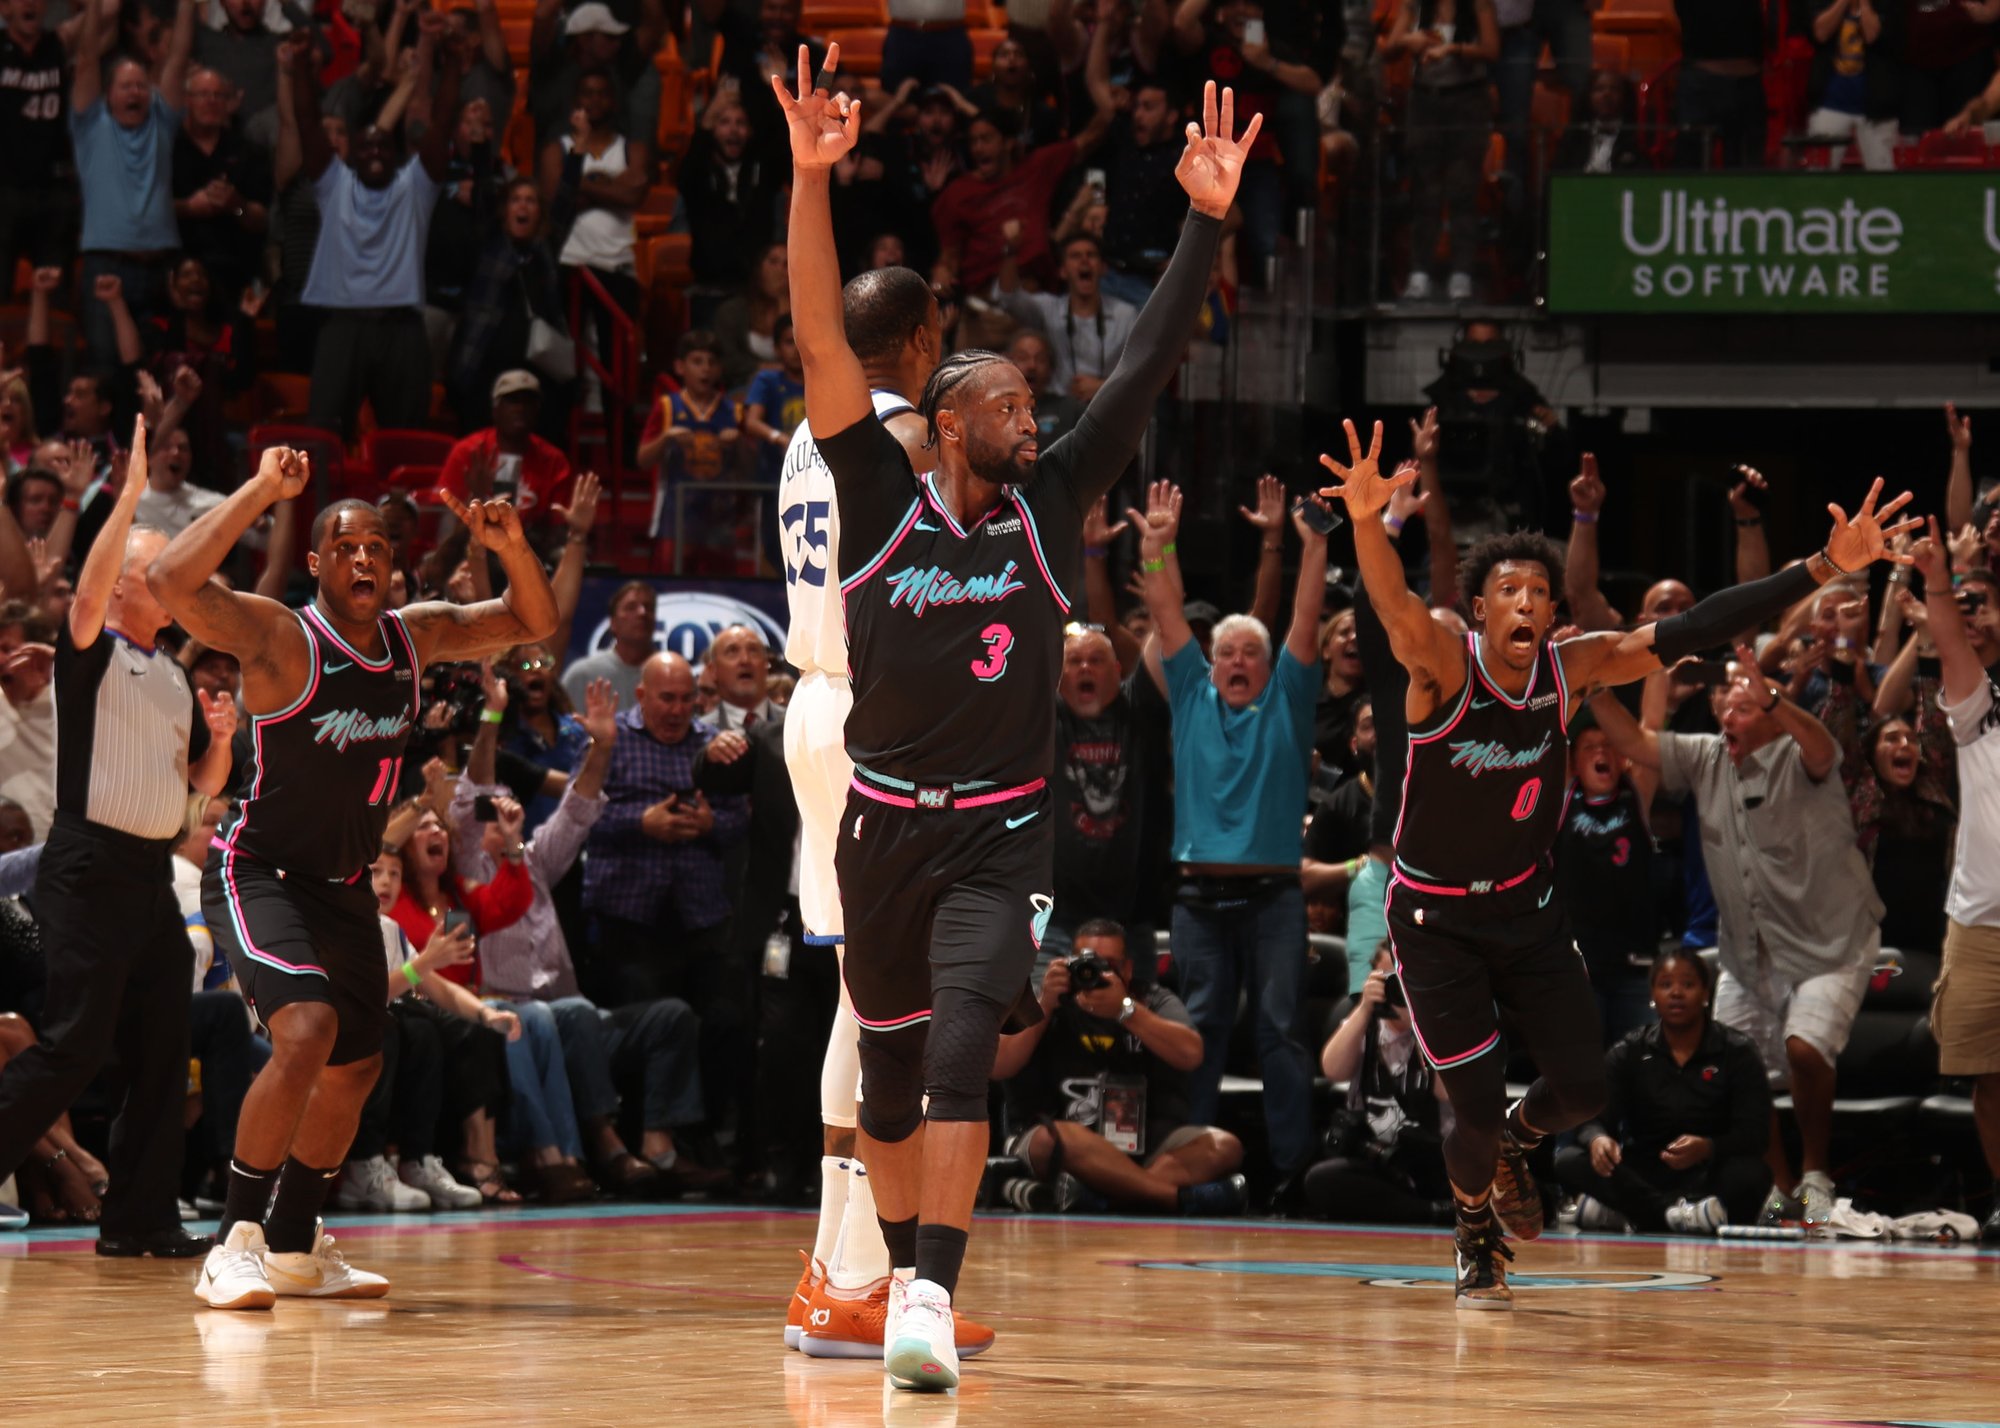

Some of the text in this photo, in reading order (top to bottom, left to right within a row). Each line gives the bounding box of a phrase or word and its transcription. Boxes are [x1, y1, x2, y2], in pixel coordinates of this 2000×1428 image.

[22, 93, 60, 120] 40
[1621, 190, 1903, 255] Ultimate
[1633, 264, 1889, 297] SOFTWARE
[886, 560, 1026, 618] Miami
[970, 623, 1015, 682] 3
[310, 703, 411, 753] Miami
[1449, 730, 1552, 778] Miami
[368, 756, 403, 806] 11
[1510, 777, 1542, 821] 0
[1612, 837, 1631, 866] 3
